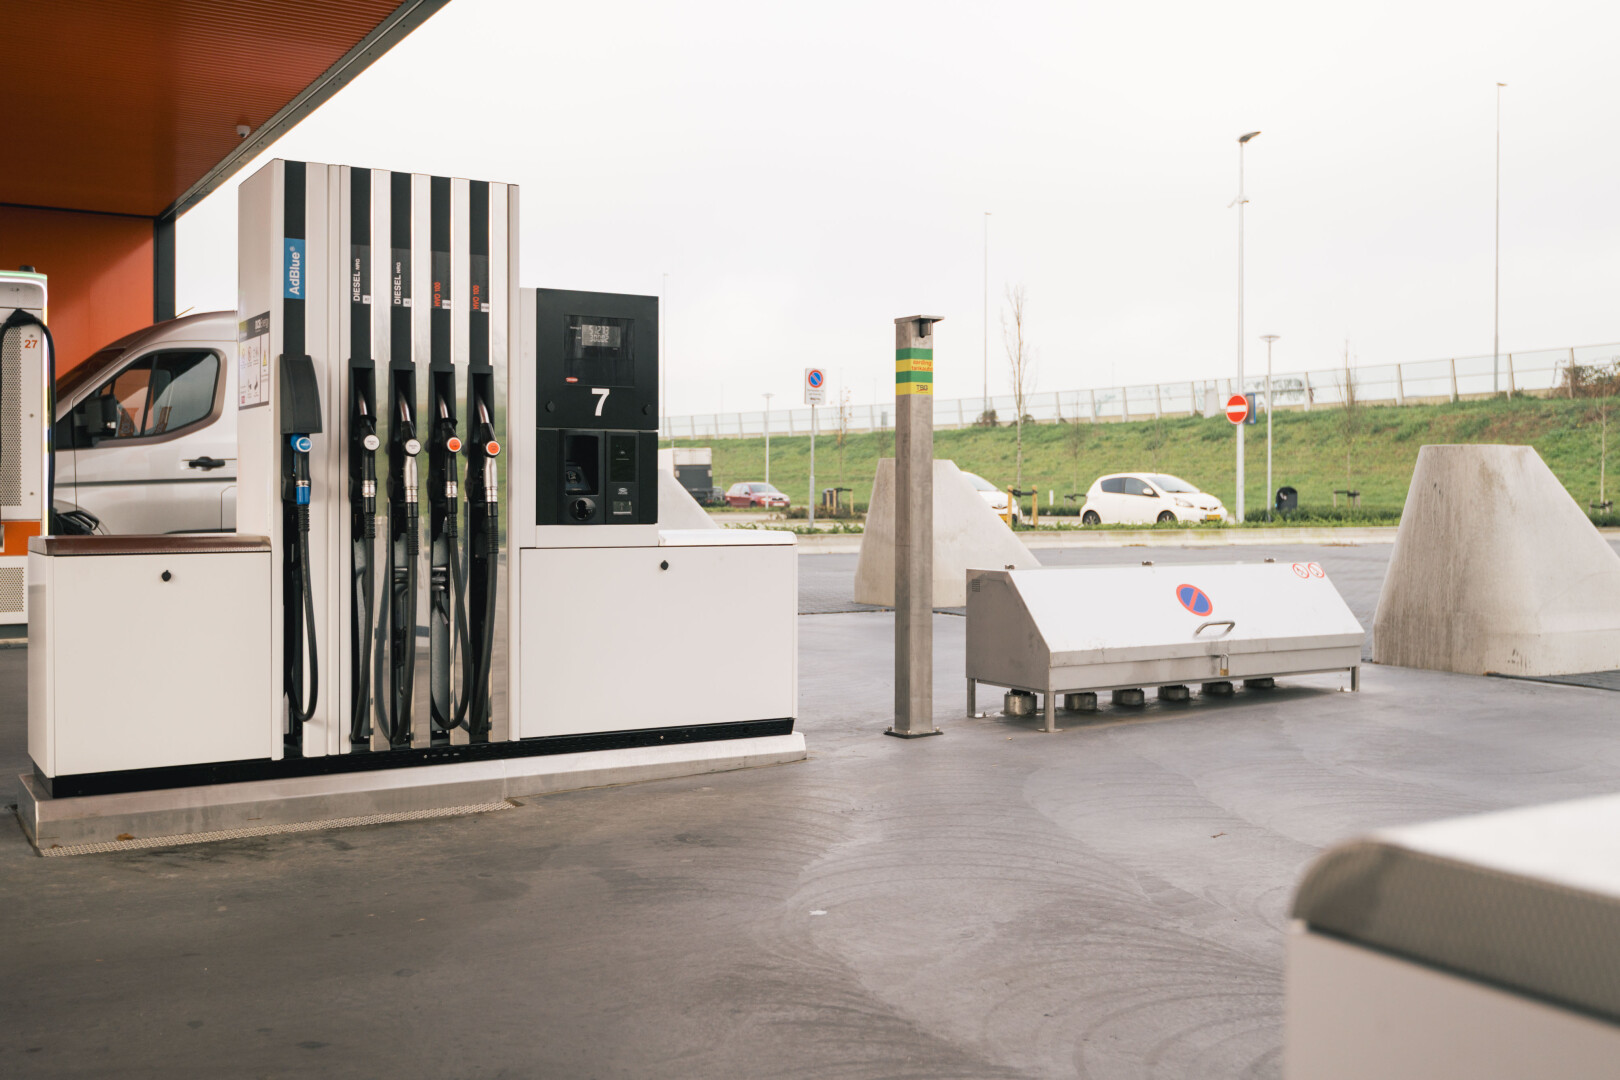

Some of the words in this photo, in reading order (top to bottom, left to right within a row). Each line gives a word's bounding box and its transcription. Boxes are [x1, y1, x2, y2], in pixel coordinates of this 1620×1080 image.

[353, 271, 361, 301] DIESEL
[393, 274, 401, 304] DIESEL
[433, 281, 441, 292] 100
[472, 284, 480, 295] 100
[433, 293, 441, 307] HVO
[472, 296, 480, 309] HVO
[24, 339, 38, 349] 27
[591, 387, 610, 417] 7
